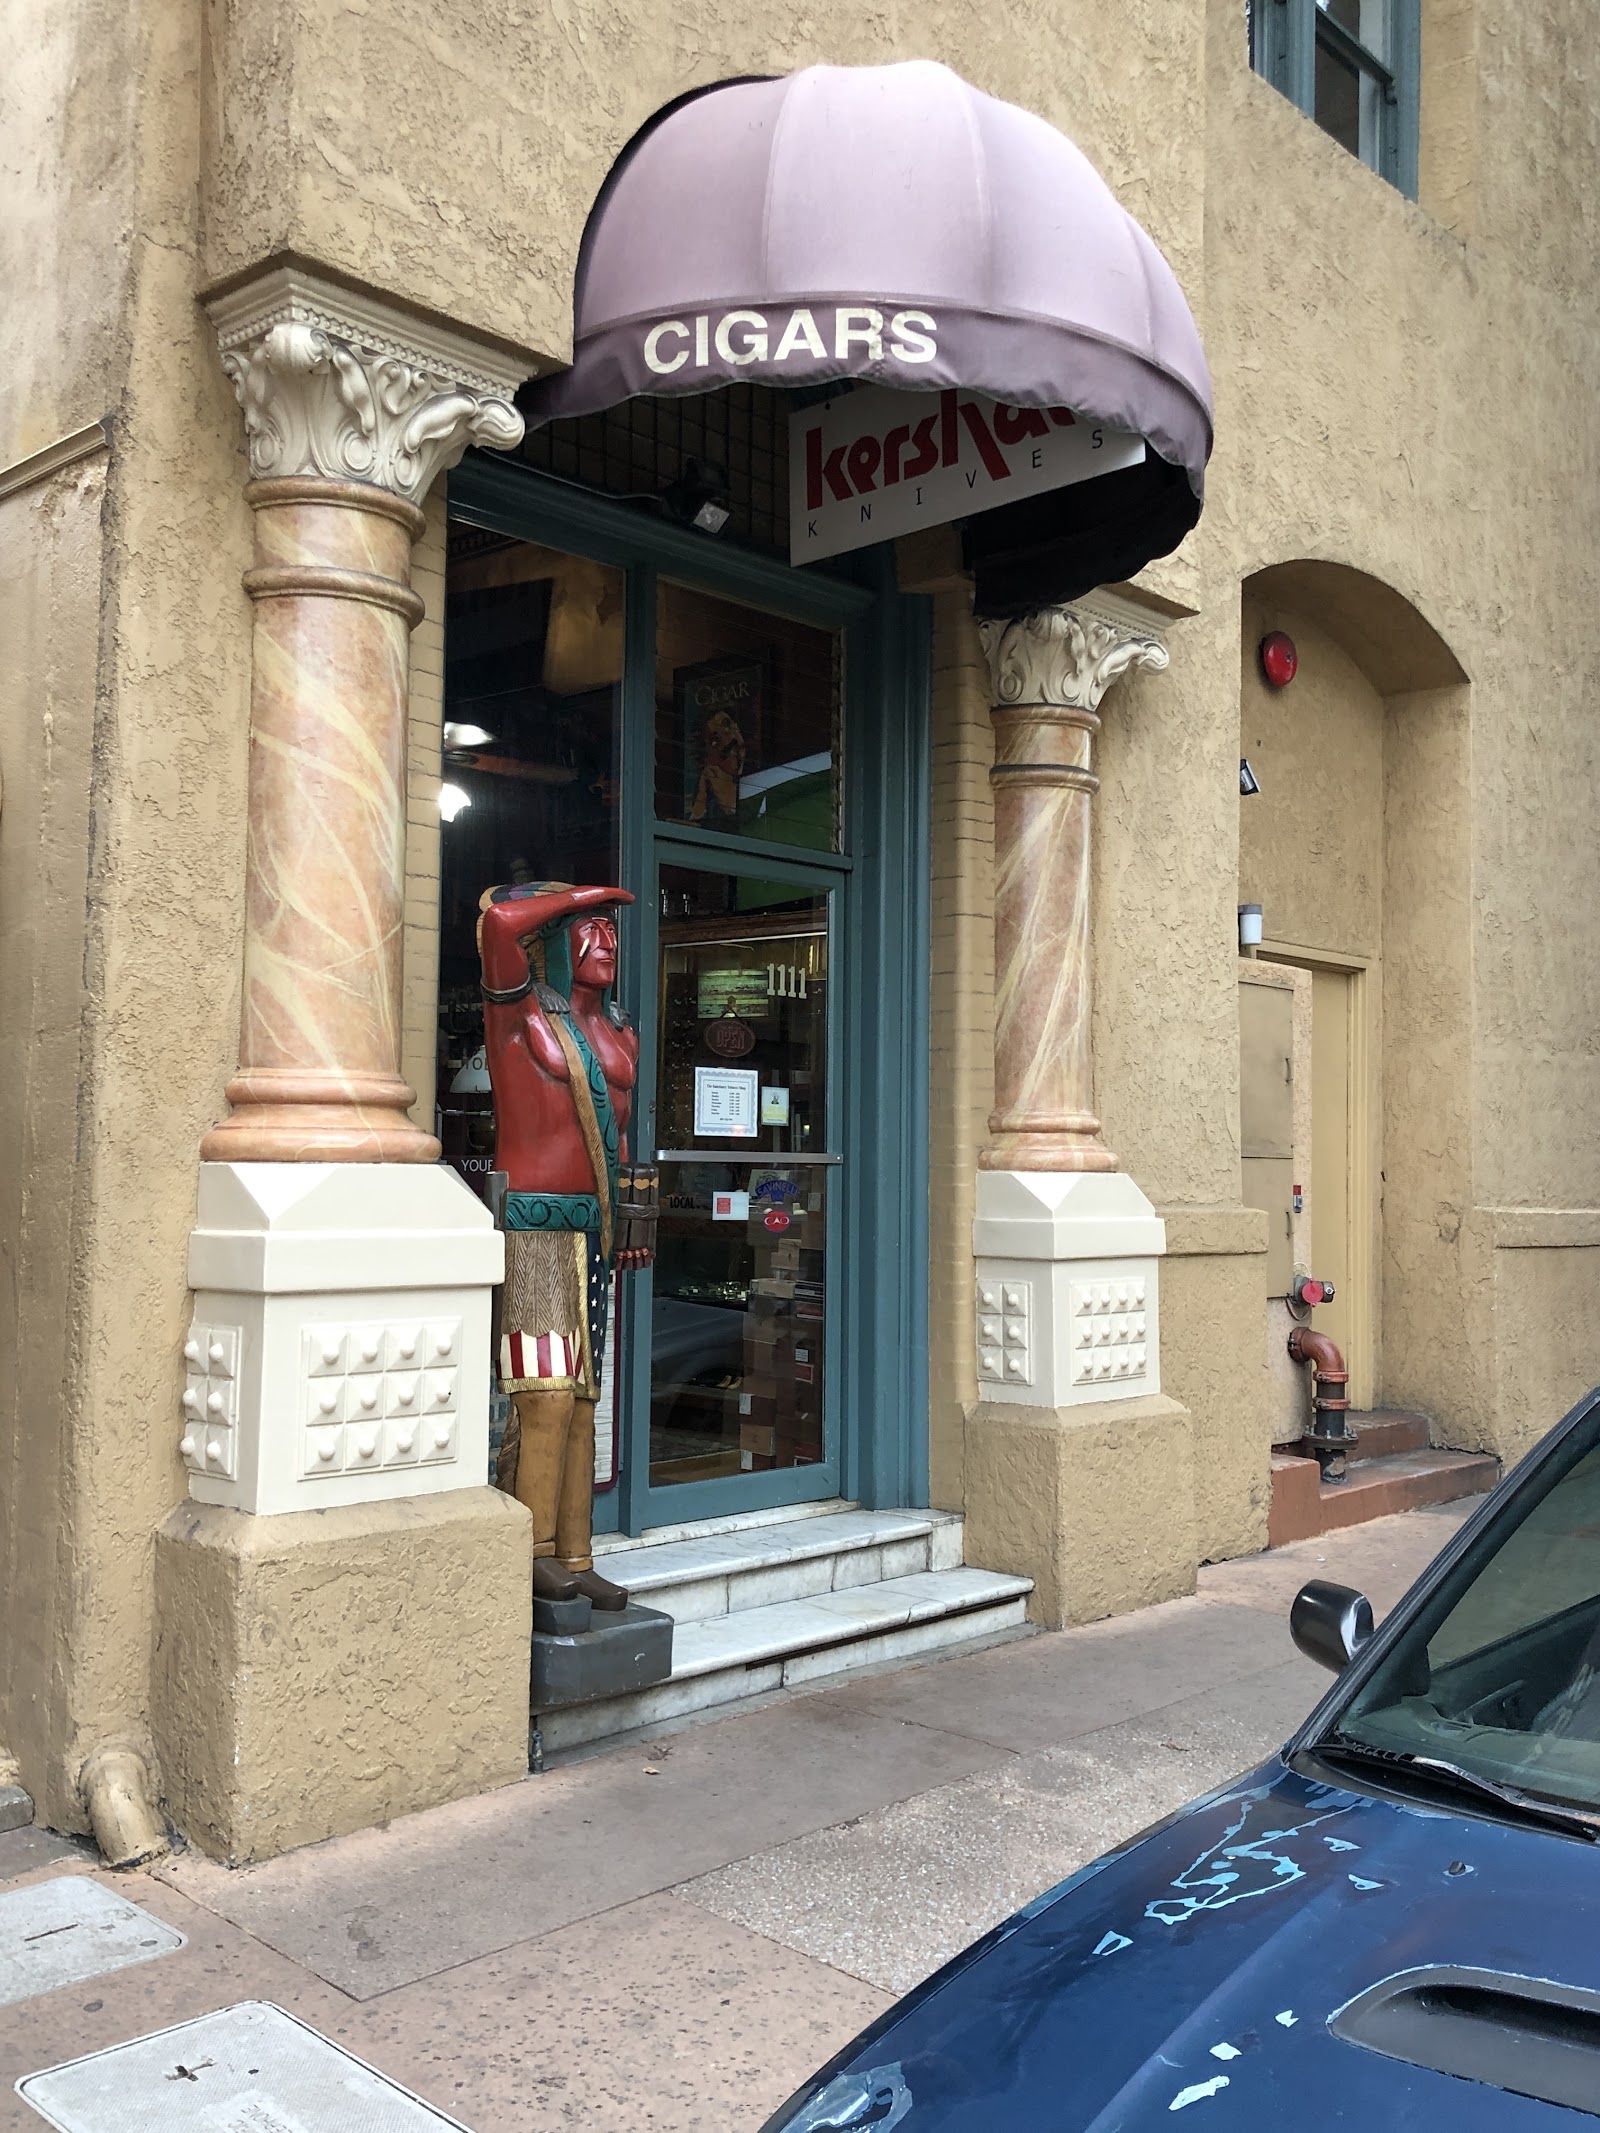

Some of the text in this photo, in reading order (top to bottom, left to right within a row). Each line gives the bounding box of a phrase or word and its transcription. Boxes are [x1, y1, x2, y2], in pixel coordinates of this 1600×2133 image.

[644, 308, 938, 375] CIGARS
[806, 388, 1076, 510] kersha
[807, 429, 1103, 538] KNIVES
[694, 681, 750, 706] CIGAR
[766, 963, 807, 1000] 1111
[716, 1030, 745, 1049] OPEN
[764, 1216, 790, 1226] CAO
